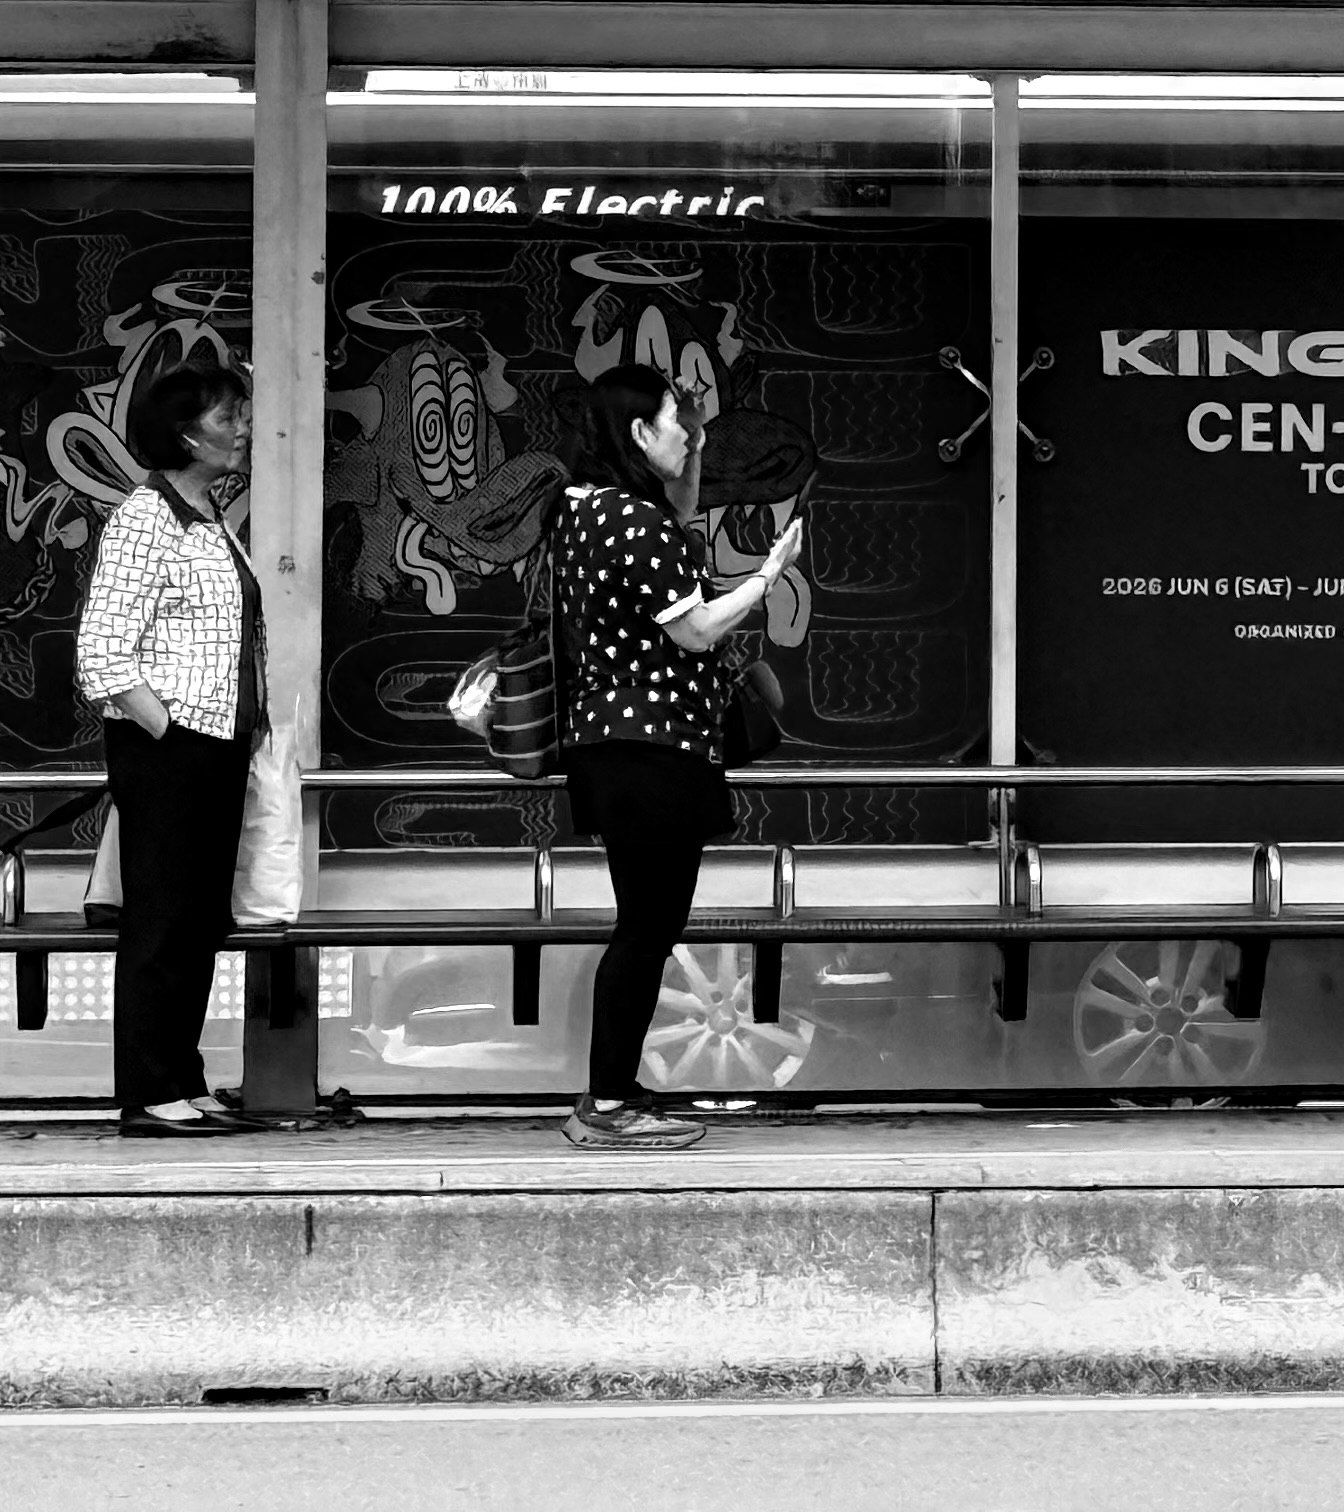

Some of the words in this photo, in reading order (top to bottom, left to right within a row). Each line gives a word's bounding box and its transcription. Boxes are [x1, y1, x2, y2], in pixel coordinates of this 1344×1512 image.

[1102, 577, 1162, 596] 2026
[1166, 577, 1209, 596] JUN
[1215, 578, 1229, 596] 6
[1234, 576, 1292, 600] (SAT)
